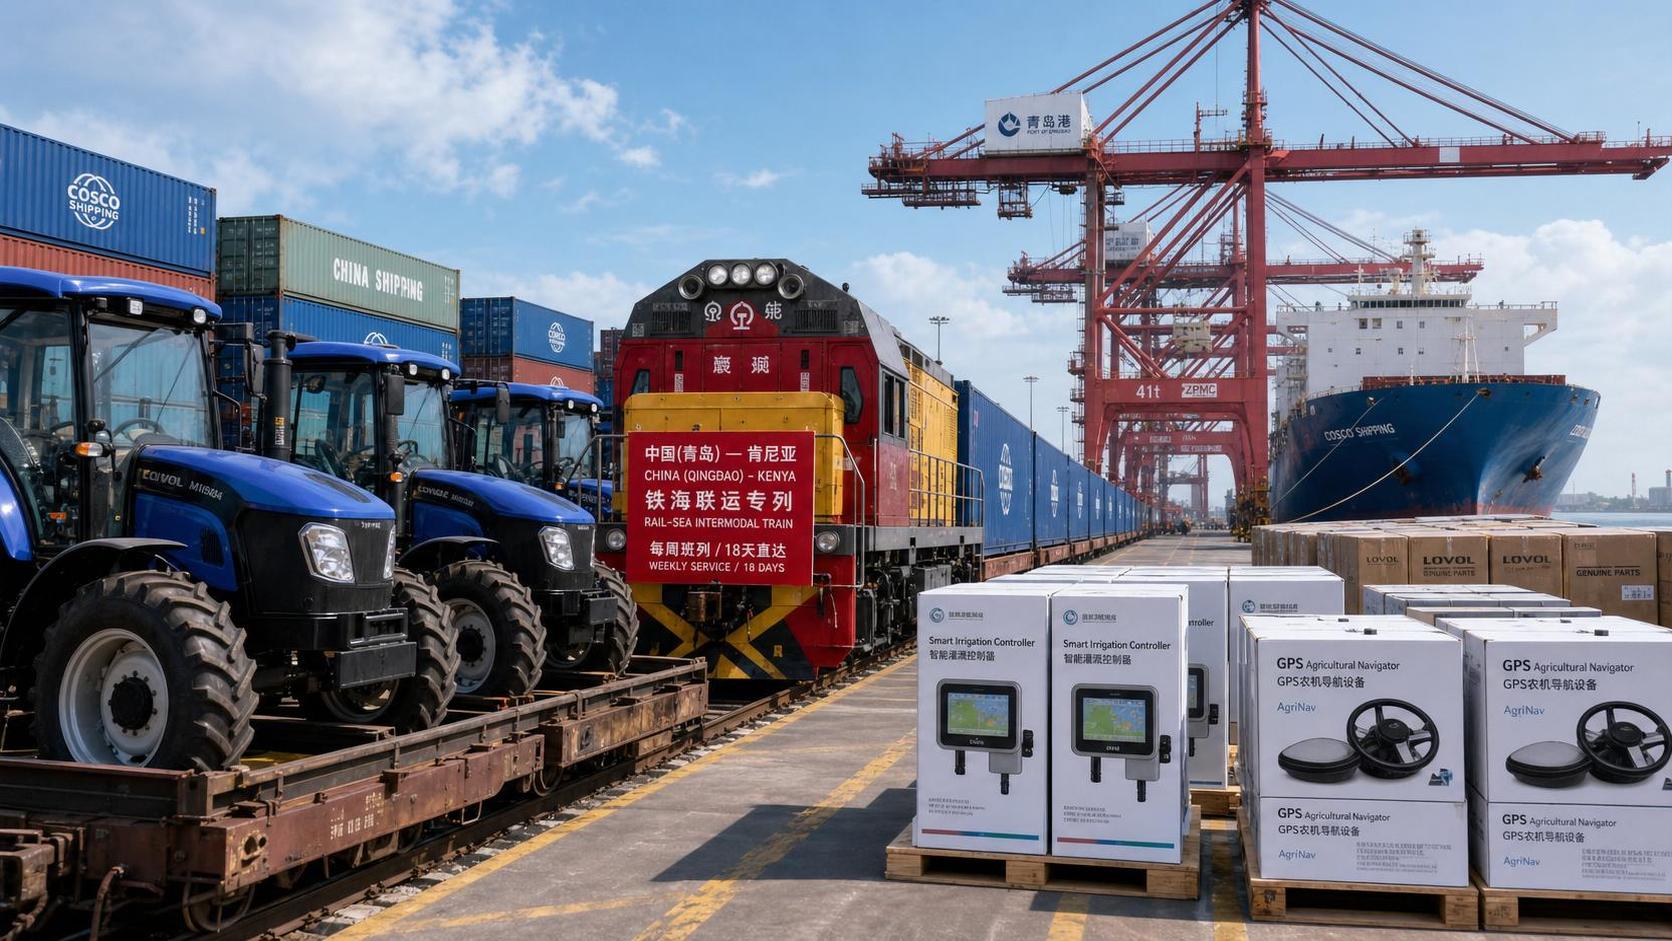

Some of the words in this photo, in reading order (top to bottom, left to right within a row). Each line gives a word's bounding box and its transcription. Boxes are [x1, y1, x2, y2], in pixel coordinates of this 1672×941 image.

[1027, 114, 1071, 129] 青岛港
[67, 184, 120, 210] COSCO
[69, 200, 119, 220] SHIPPING
[333, 258, 369, 288] CHINA
[375, 270, 423, 301] SHIPPING
[1136, 384, 1160, 399] 41t
[1185, 384, 1216, 395] ZPMC
[1324, 428, 1354, 441] COSCO
[1355, 423, 1396, 437] SHIPPING
[644, 444, 720, 463] 中国(青岛)
[747, 444, 797, 463] 肯尼亚
[645, 469, 680, 481] CHINA
[757, 470, 797, 482] KENYA
[645, 489, 793, 512] 铁海联运专列
[644, 516, 692, 528] RAIL-SEA
[695, 517, 760, 529] INTERMODAL
[762, 518, 794, 529] TRAIN
[649, 541, 710, 558] 每周班列
[724, 542, 787, 559] 18天直达
[1423, 555, 1476, 565] LOVOL
[1502, 555, 1552, 564] LOVOL
[649, 561, 688, 571] WEEKLY
[690, 562, 731, 572] SERVICE
[744, 563, 755, 573] 18
[758, 563, 785, 573] DAYS
[1576, 569, 1613, 577] GENUINE
[1614, 569, 1641, 577] PARTS
[1188, 618, 1215, 627] ntroller
[929, 636, 953, 646] Smart
[955, 637, 992, 648] Irrigation
[994, 637, 1036, 647] Controller
[1063, 639, 1088, 649] Smart
[1090, 640, 1128, 651] Irrigation
[1129, 640, 1171, 650] Controller
[1276, 657, 1303, 670] GPS
[1305, 660, 1356, 672] Agricultural
[1357, 660, 1400, 672] Navigator
[1502, 659, 1531, 672] GPS
[1534, 662, 1587, 674] Agricultural
[1589, 663, 1635, 675] Navigator
[1277, 702, 1317, 714] AgriNav
[1504, 705, 1545, 717] AgriNav
[1277, 807, 1303, 819] GPS
[1304, 811, 1352, 822] Agricultural
[1352, 813, 1391, 823] Navigator
[1502, 814, 1527, 825] GPS
[1529, 817, 1577, 828] Agricultural
[1578, 818, 1617, 829] Navigator
[1278, 849, 1316, 860] AgriNav
[1504, 856, 1541, 867] AgriNav
